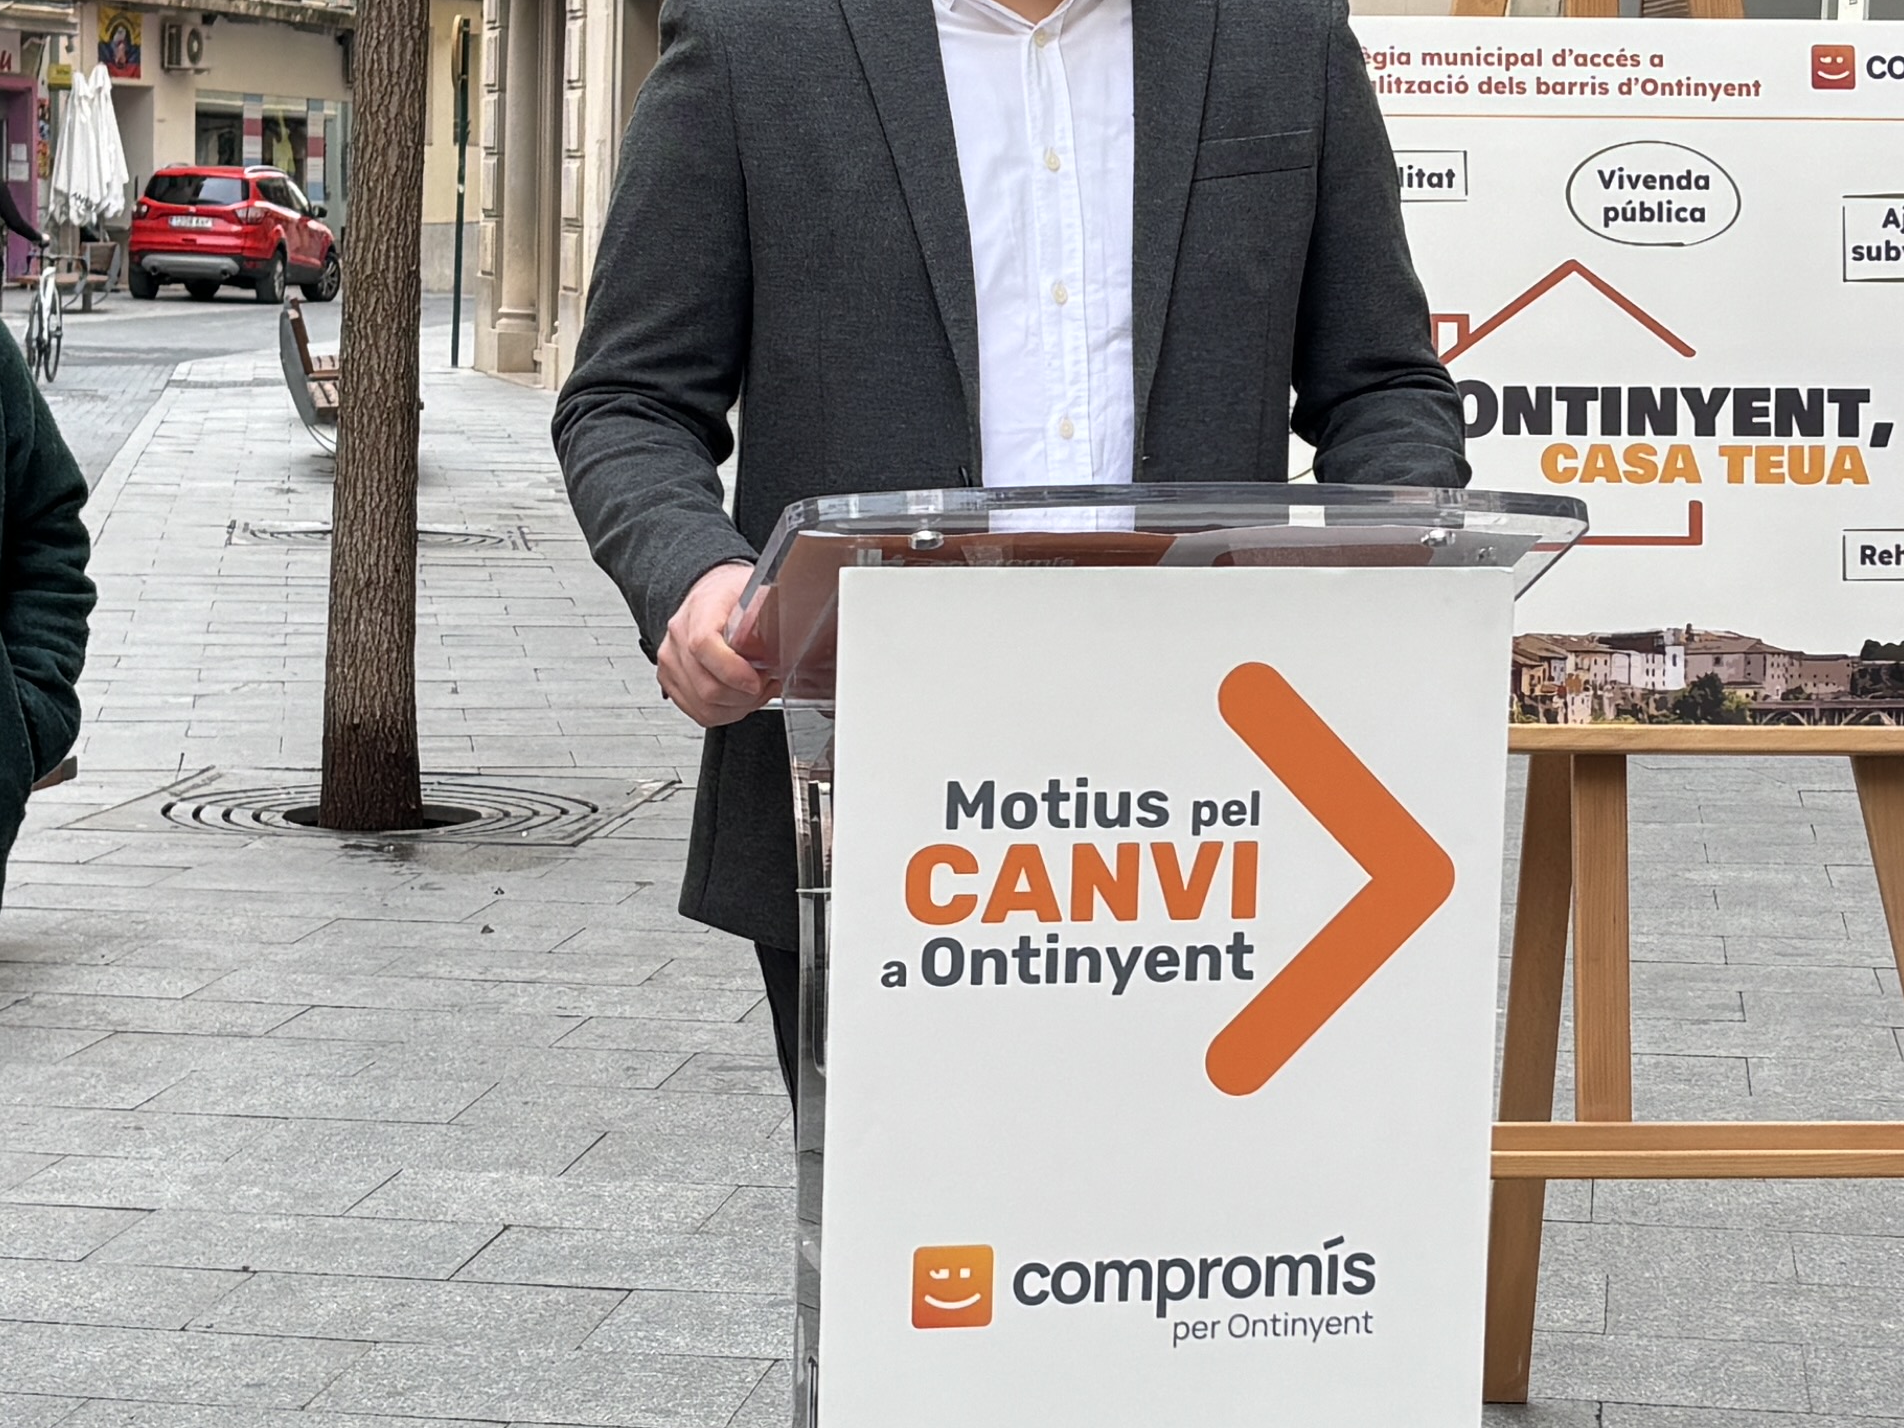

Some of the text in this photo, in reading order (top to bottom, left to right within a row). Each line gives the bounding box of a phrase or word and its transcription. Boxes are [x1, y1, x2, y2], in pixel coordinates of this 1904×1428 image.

[1421, 46, 1543, 71] municipal
[1649, 53, 1664, 68] a
[1477, 76, 1528, 95] dels
[1535, 76, 1610, 96] barris
[1596, 166, 1710, 191] Vivenda
[1603, 198, 1706, 226] pública
[1540, 443, 1870, 486] CASA TEUA
[945, 776, 1261, 836] Motius pel
[904, 841, 1259, 926] CANVI
[880, 932, 1254, 996] a Ontinyent
[1012, 1235, 1376, 1318] compromís
[1172, 1310, 1374, 1349] per Ontinyent
